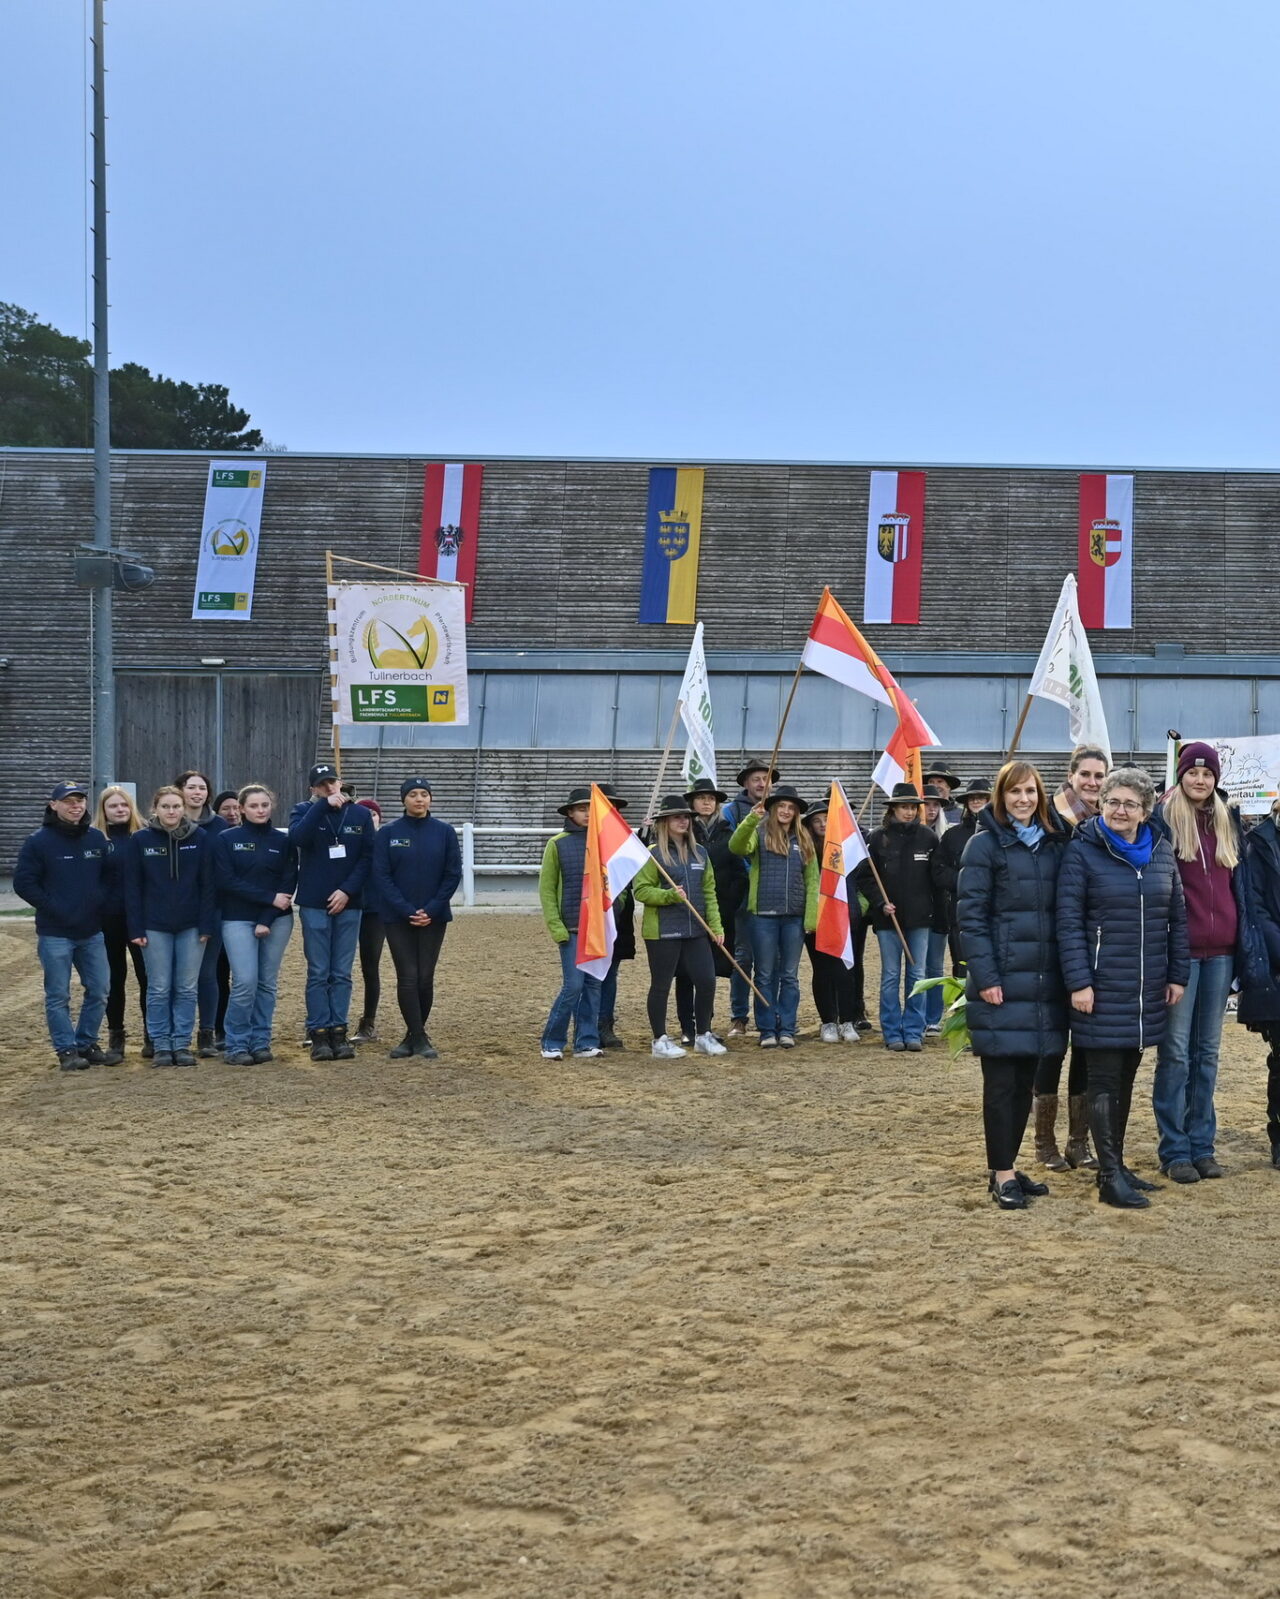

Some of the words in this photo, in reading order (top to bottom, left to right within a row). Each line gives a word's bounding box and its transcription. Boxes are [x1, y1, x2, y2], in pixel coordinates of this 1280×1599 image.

[215, 472, 235, 480] LFS
[201, 594, 221, 603] LFS
[371, 594, 431, 609] NORBERTINUM
[348, 609, 367, 664] Bildungszentrum
[369, 671, 432, 681] Tullnerbach
[358, 689, 397, 705] LFS
